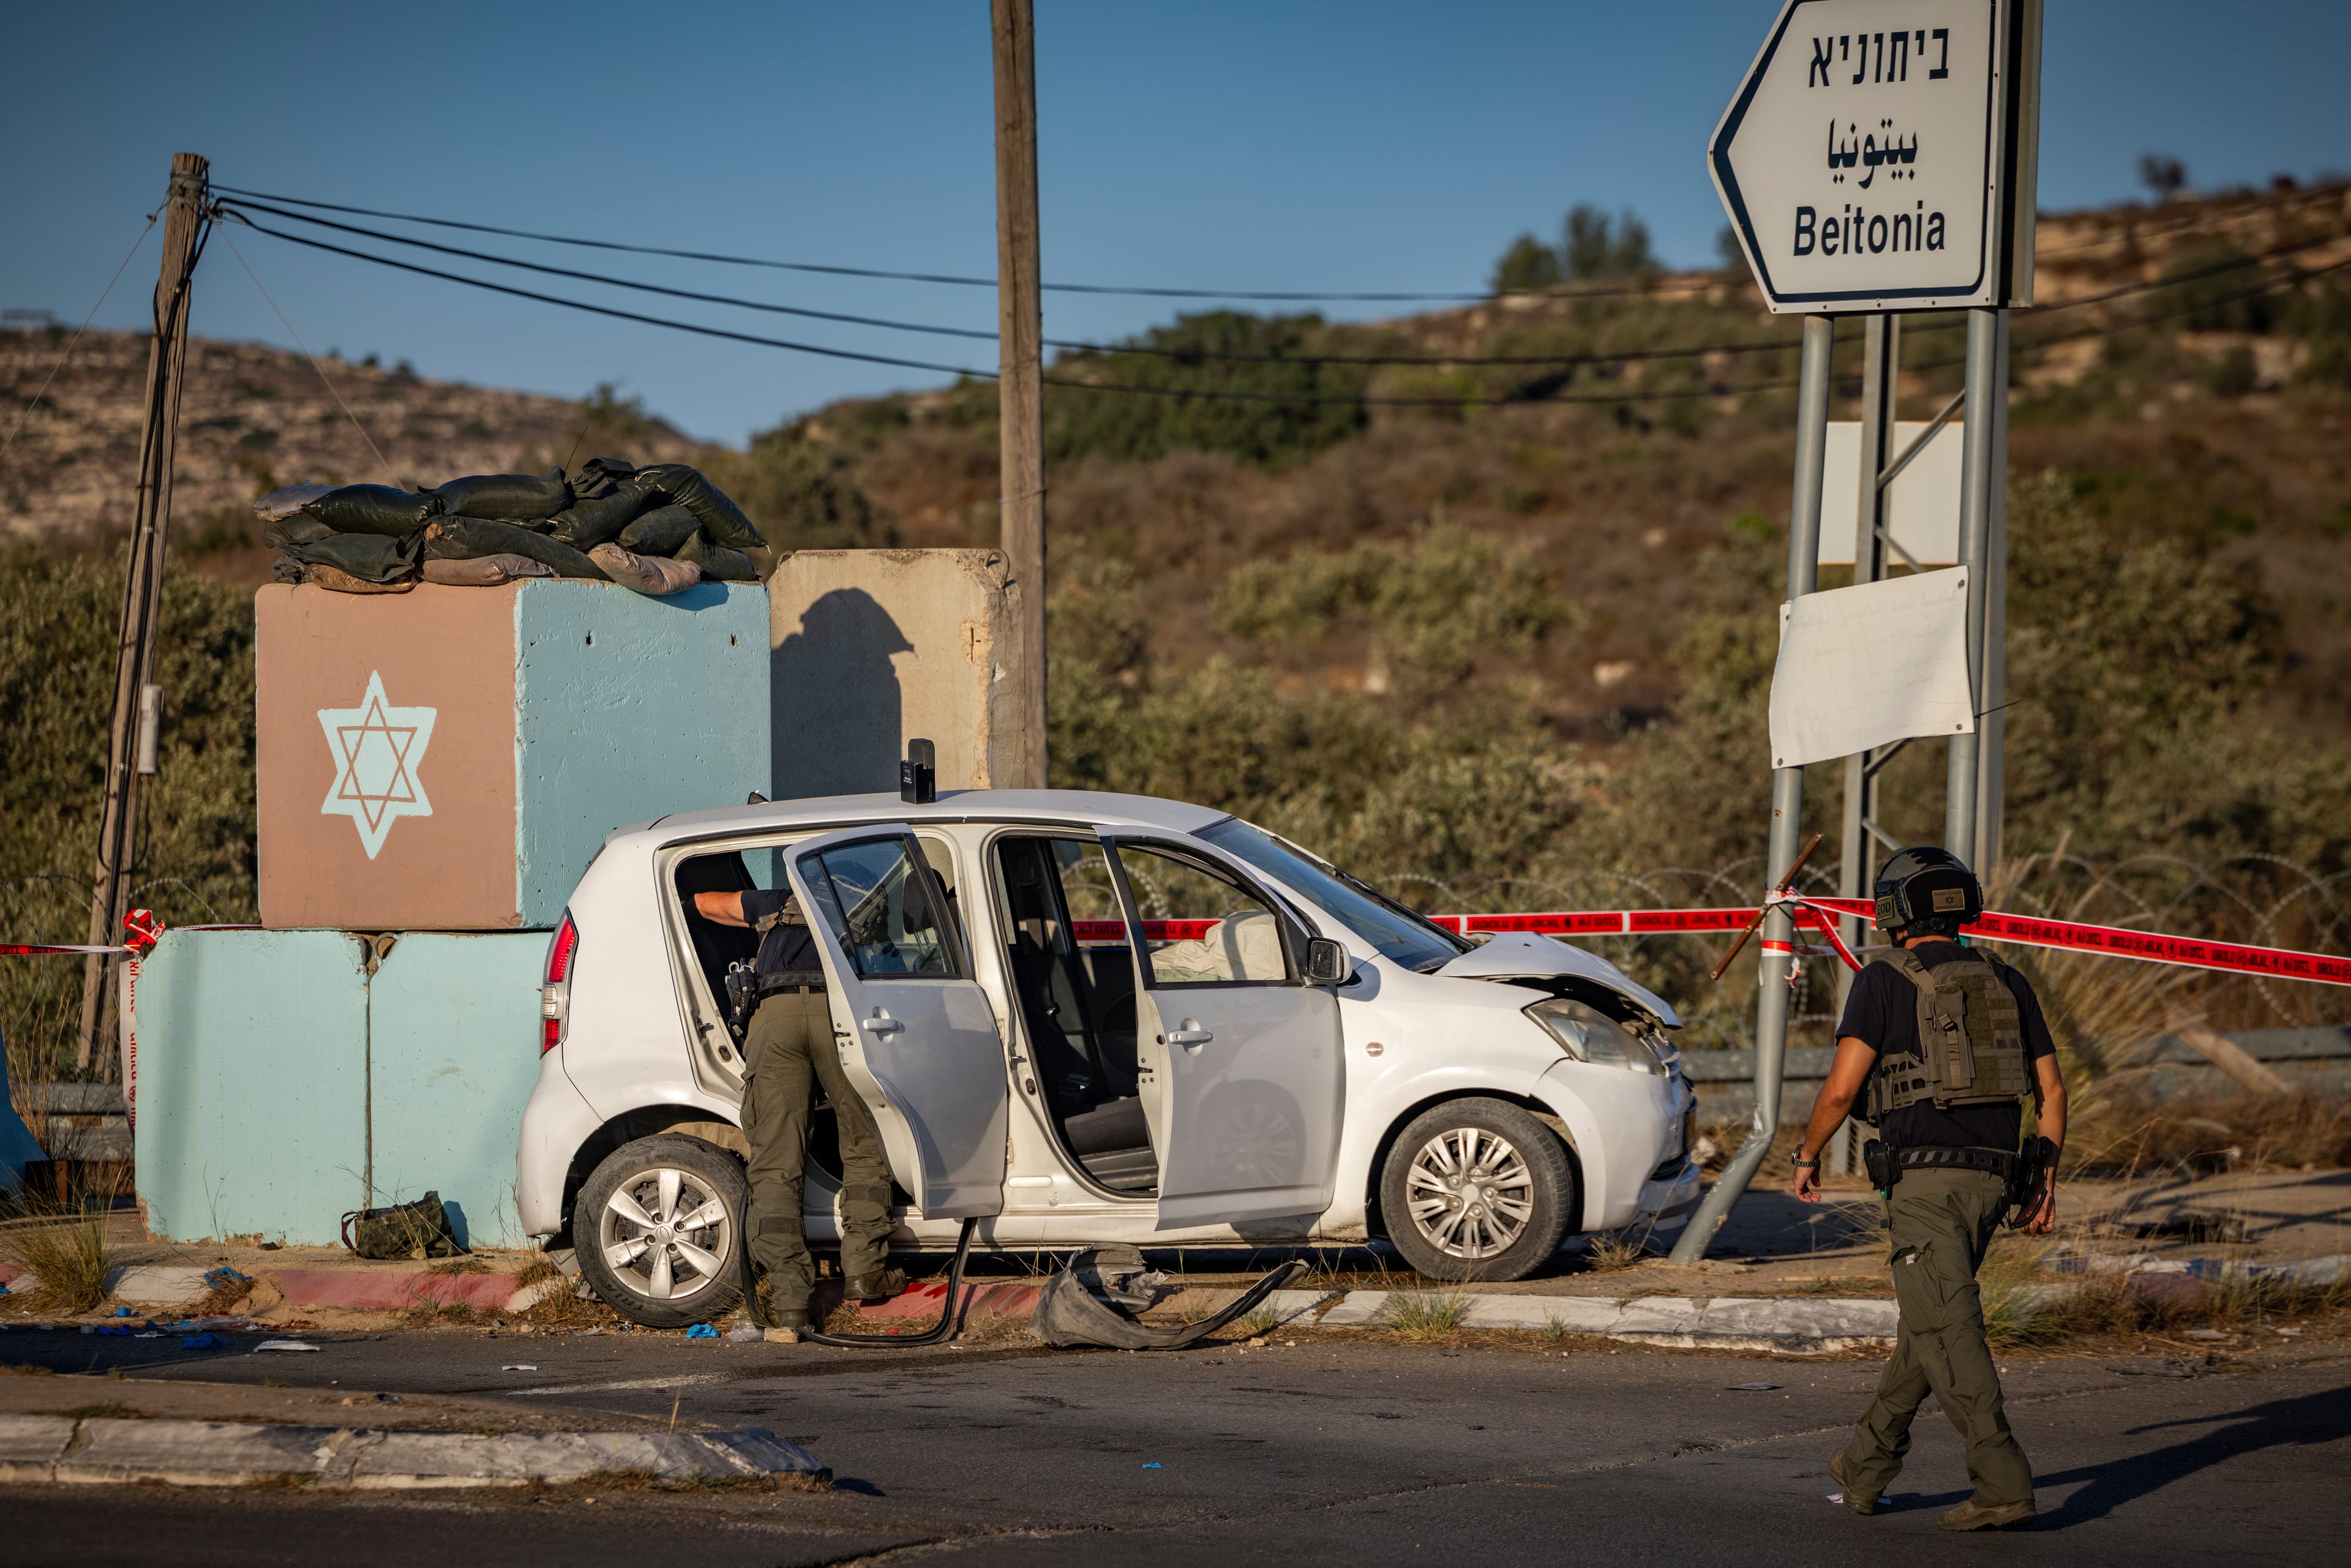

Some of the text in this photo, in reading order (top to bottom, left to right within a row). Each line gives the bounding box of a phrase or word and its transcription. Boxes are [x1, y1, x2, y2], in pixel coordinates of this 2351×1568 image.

[1809, 28, 1949, 88] ביתוניא
[1828, 118, 1918, 189] بيتونيا
[1793, 200, 1945, 257] Beitonia
[1095, 925, 1123, 934] מעבר
[1877, 902, 1891, 915] EOD
